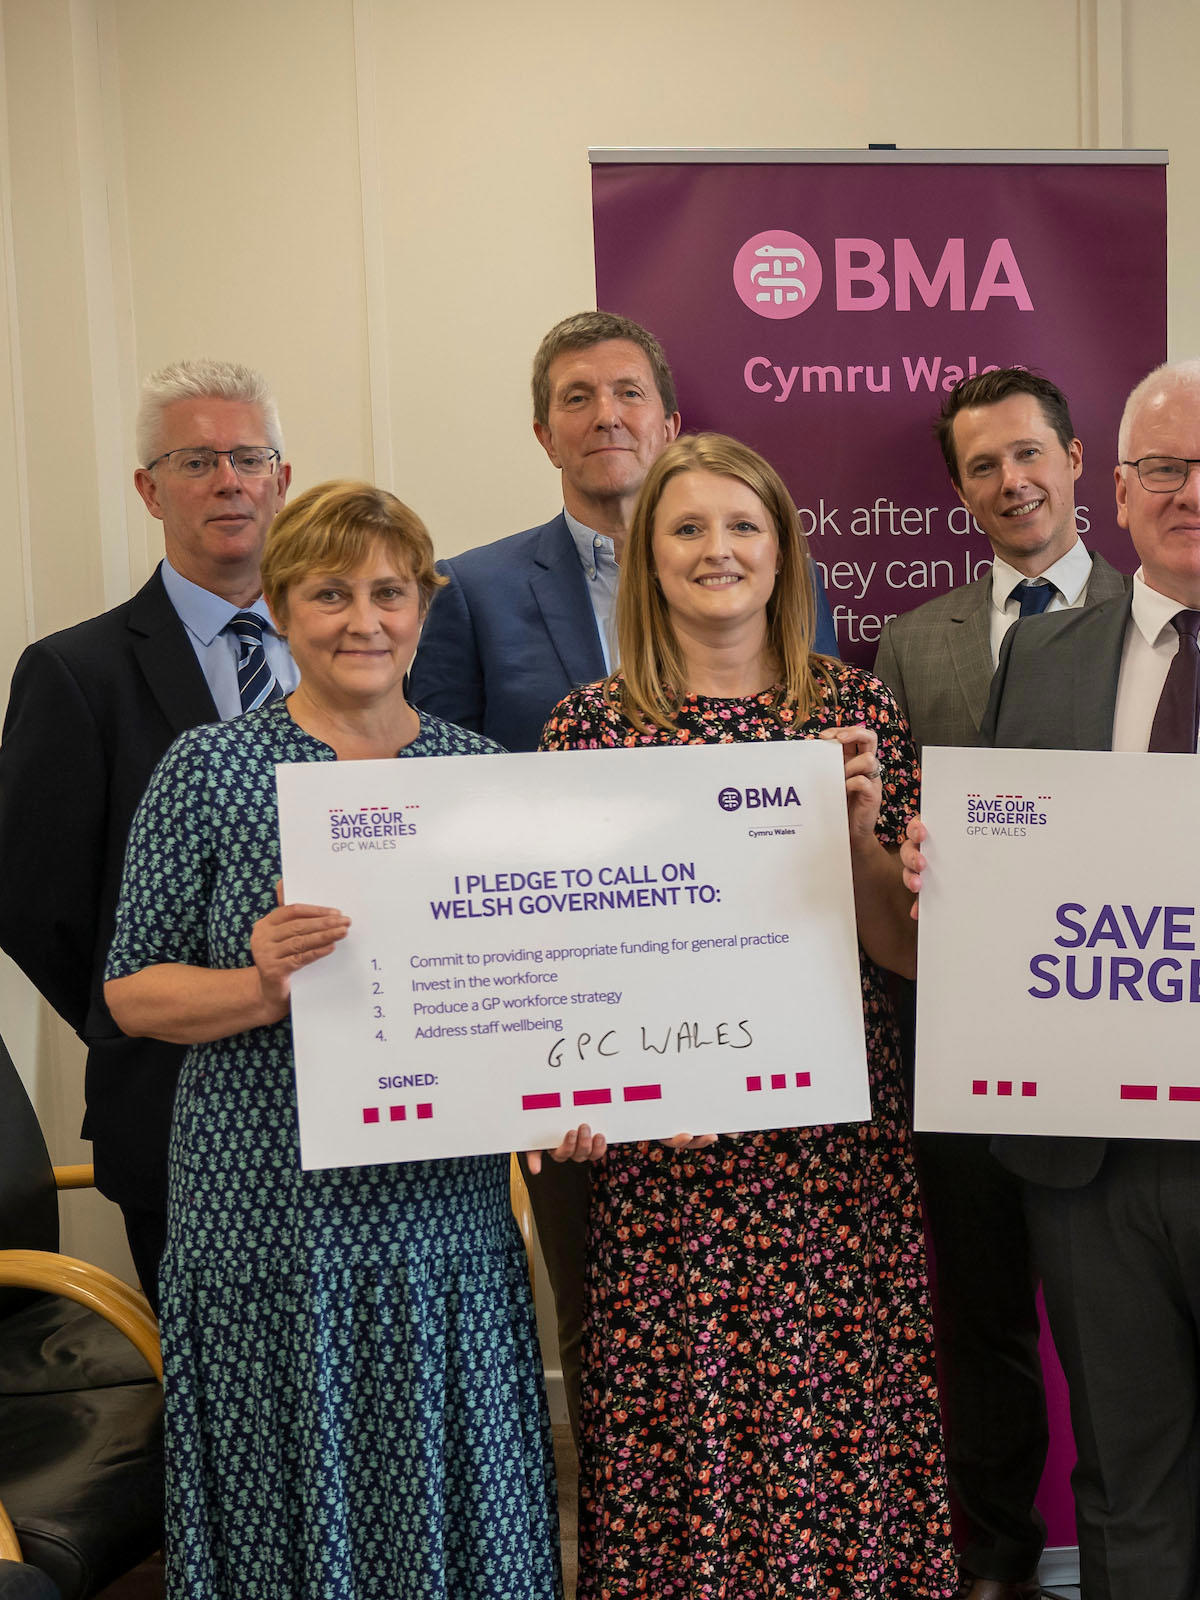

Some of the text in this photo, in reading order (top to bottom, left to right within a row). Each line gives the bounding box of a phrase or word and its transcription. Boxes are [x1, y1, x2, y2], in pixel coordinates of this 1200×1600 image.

[834, 238, 1035, 311] BMA
[743, 356, 1029, 403] Cymru Wal
[797, 498, 842, 537] ok
[850, 497, 939, 536] after
[885, 560, 954, 589] can
[832, 605, 897, 642] fter
[745, 786, 801, 809] BMA
[967, 799, 1035, 813] SAVE OUR
[330, 812, 403, 827] SAVE OUR
[331, 823, 417, 839] SURGERIES
[967, 811, 1047, 825] SURGERIES
[748, 828, 796, 838] Cymru Wales
[966, 826, 1027, 837] GPC WALES
[331, 839, 397, 853] GPC WALES
[454, 862, 696, 895] I PLEDGE TO CALL ON
[430, 884, 721, 920] WELSH GOVERNMENT TO:
[1054, 902, 1195, 951] SAVE
[370, 932, 790, 971] 1. Commit to providing appropriate funding for general practice
[372, 971, 559, 995] 2. Invest in the workforce
[374, 990, 623, 1018] 3. Produce a GP workforce strategy
[375, 1017, 564, 1042] 4. Address staff wellbeing
[547, 1020, 753, 1069] GPC WALES
[378, 1072, 439, 1090] SIGNED:
